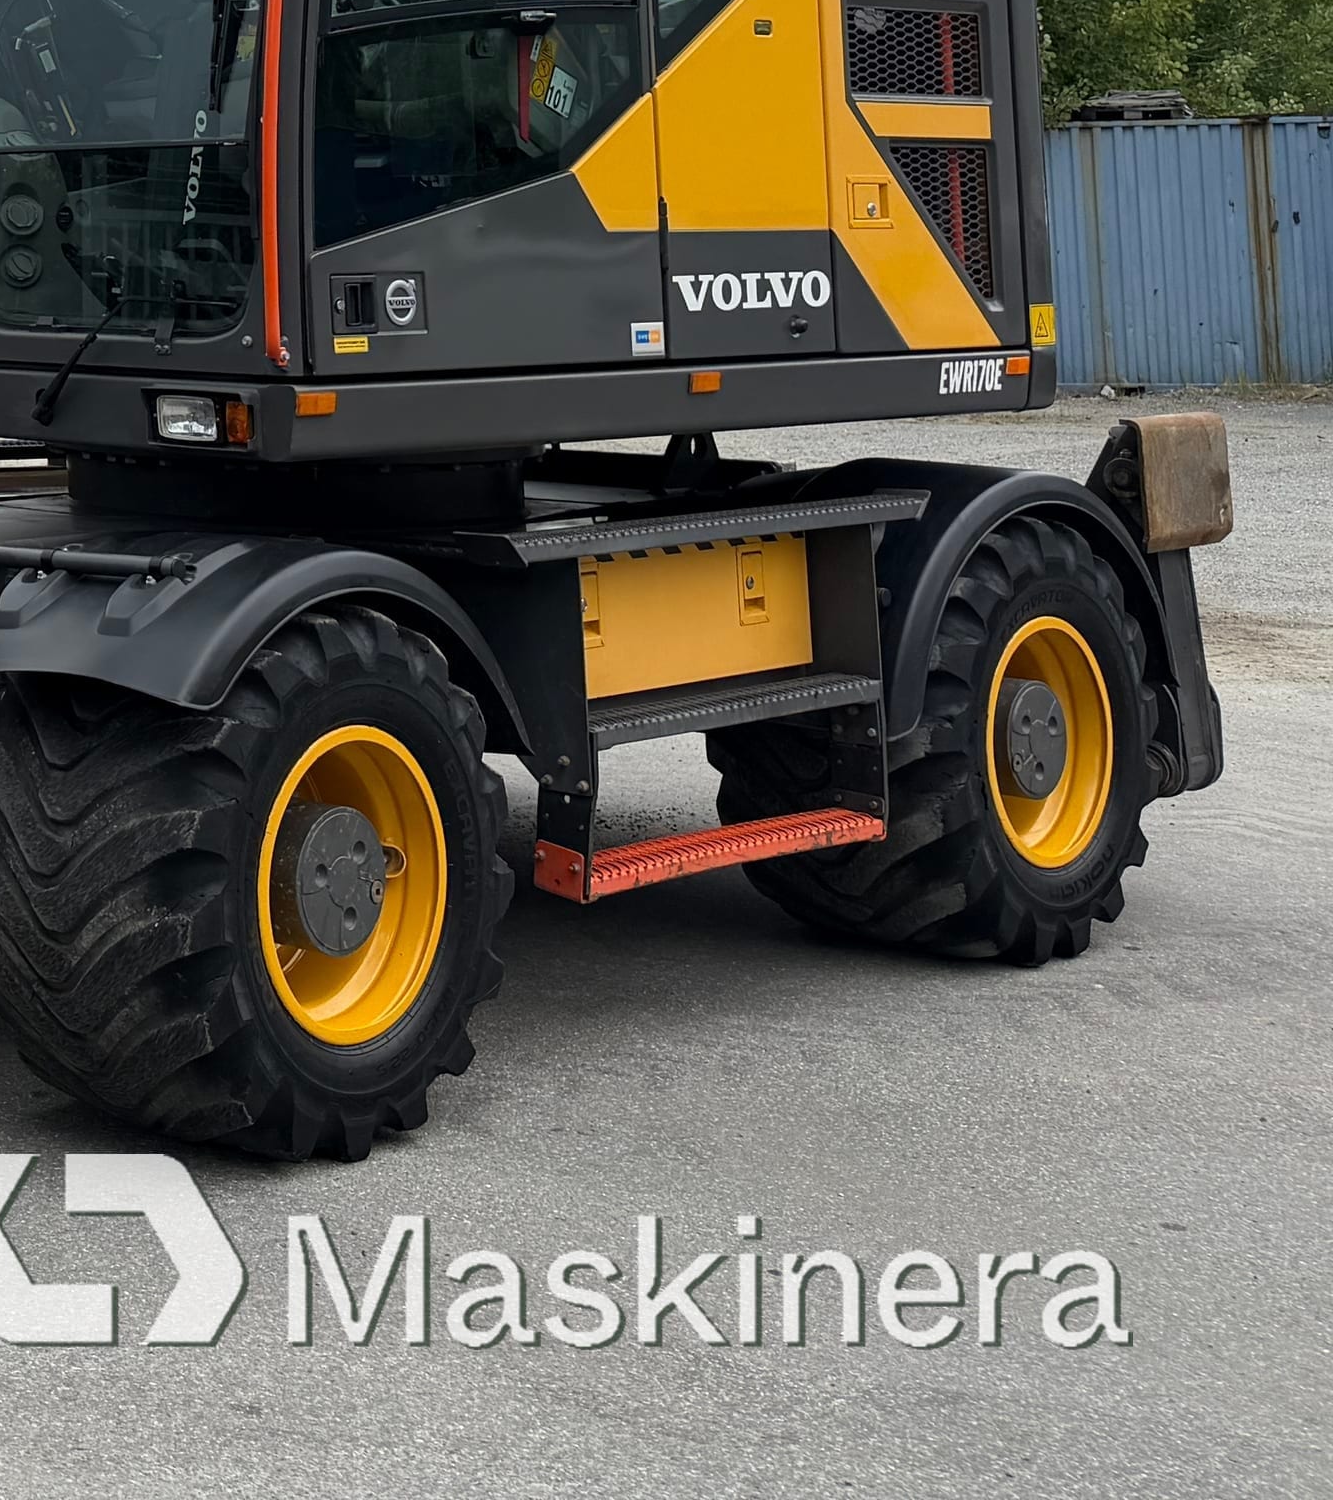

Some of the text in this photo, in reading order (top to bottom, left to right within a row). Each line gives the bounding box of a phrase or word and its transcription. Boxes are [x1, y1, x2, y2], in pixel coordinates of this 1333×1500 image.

[547, 85, 569, 113] 101
[182, 109, 207, 225] VOLVO
[388, 299, 416, 307] VOLVO
[672, 270, 831, 312] VOLVO
[939, 358, 1004, 394] EWR170E
